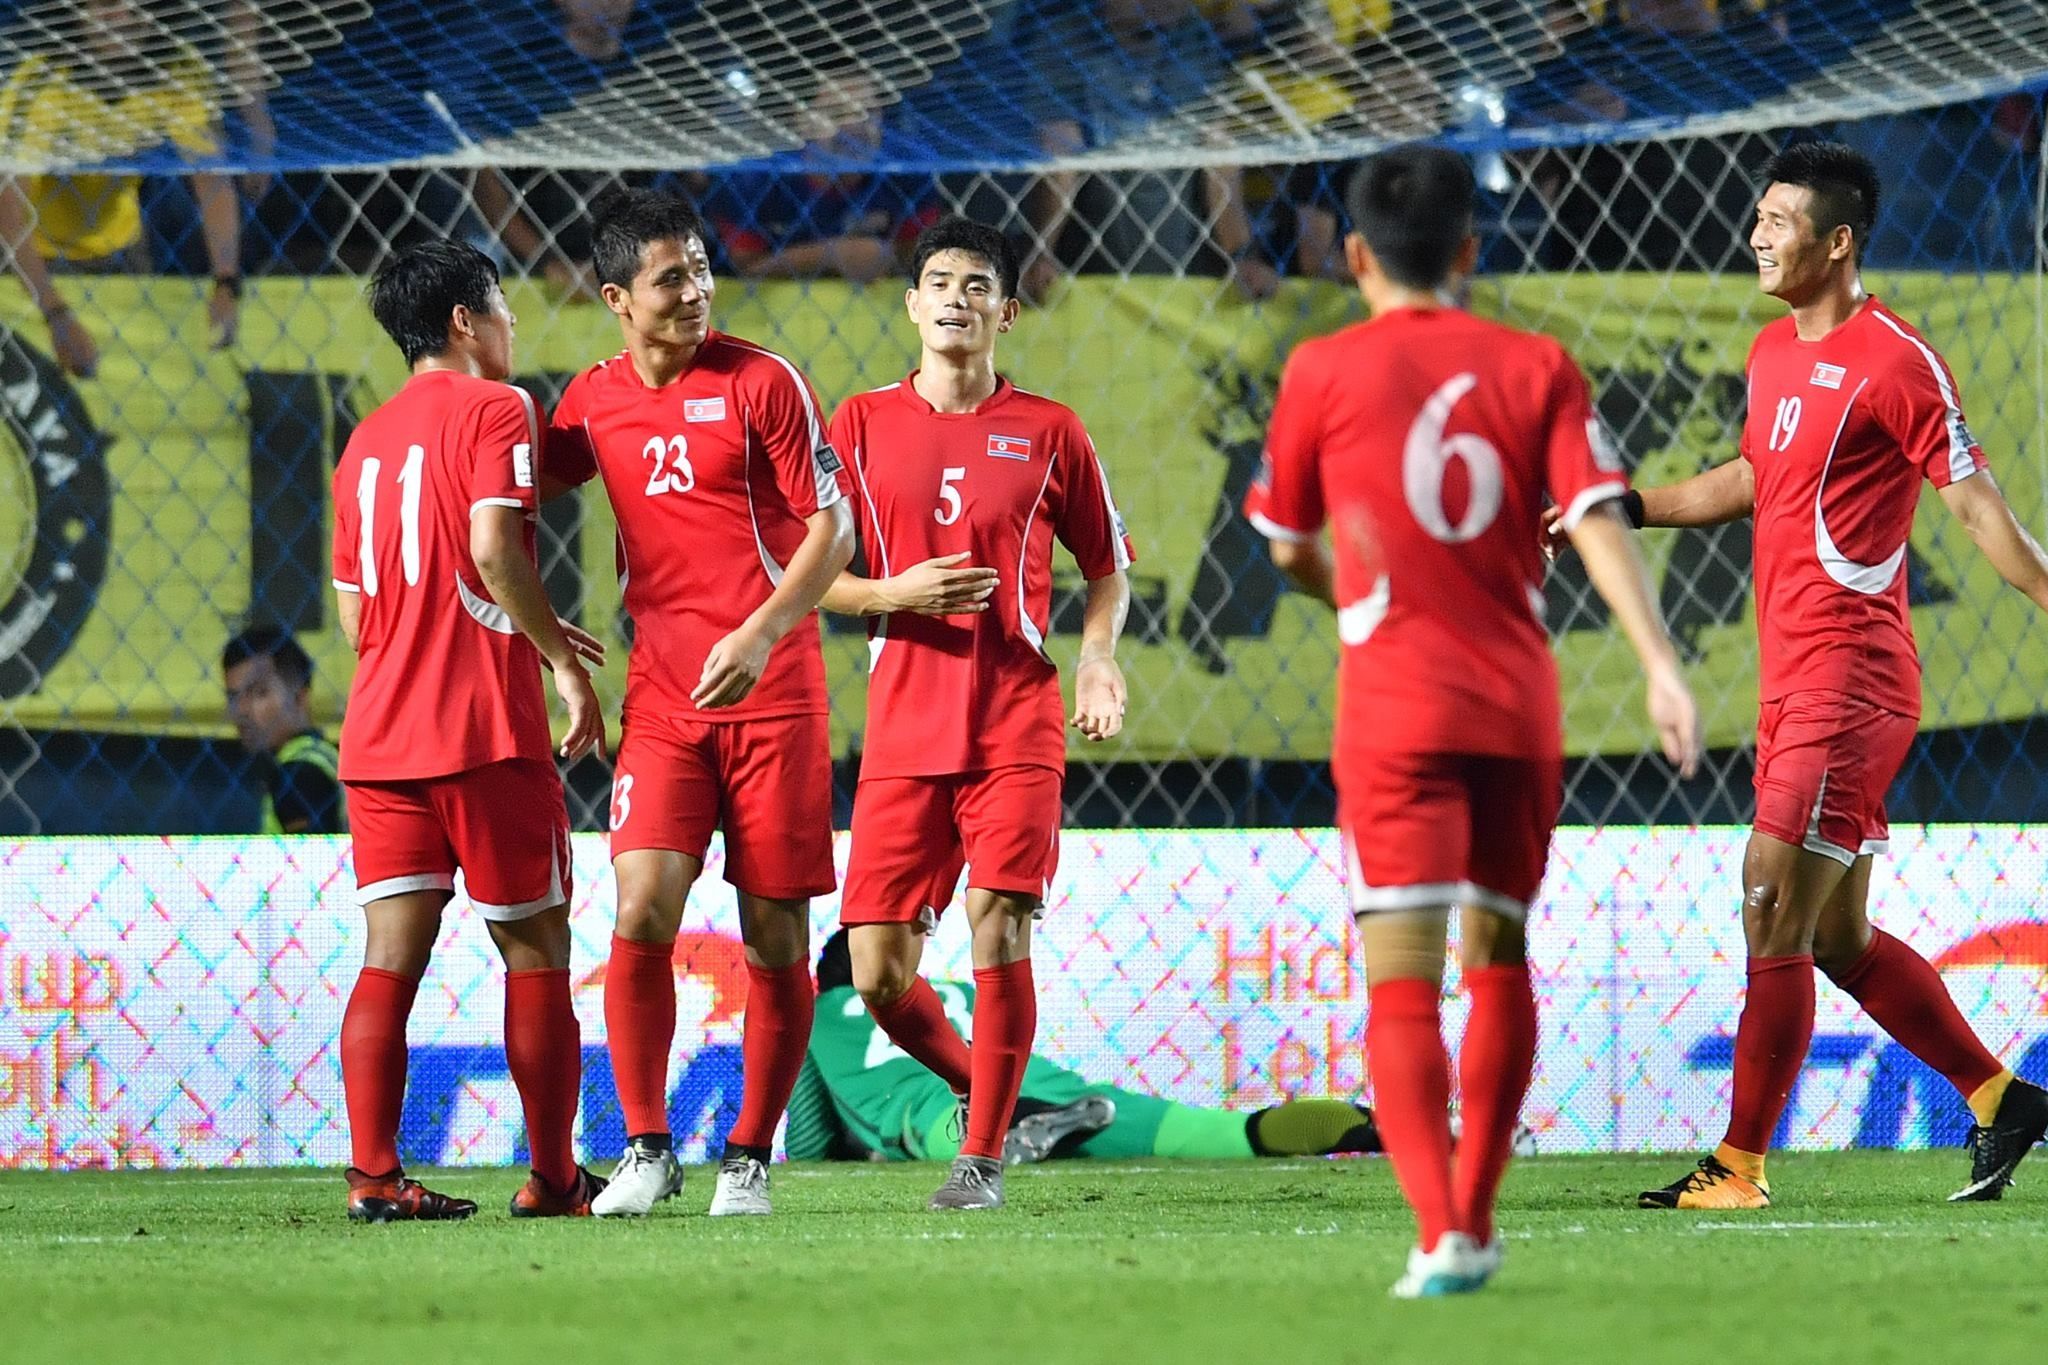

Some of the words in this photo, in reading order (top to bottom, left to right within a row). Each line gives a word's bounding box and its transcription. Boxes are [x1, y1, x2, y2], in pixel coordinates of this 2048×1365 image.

[1768, 396, 1803, 452] 19
[642, 434, 695, 496] 23
[1403, 372, 1505, 543] 6
[356, 444, 425, 597] 11
[934, 466, 966, 526] 5
[610, 773, 634, 832] 3
[1216, 924, 1360, 1002] Hid
